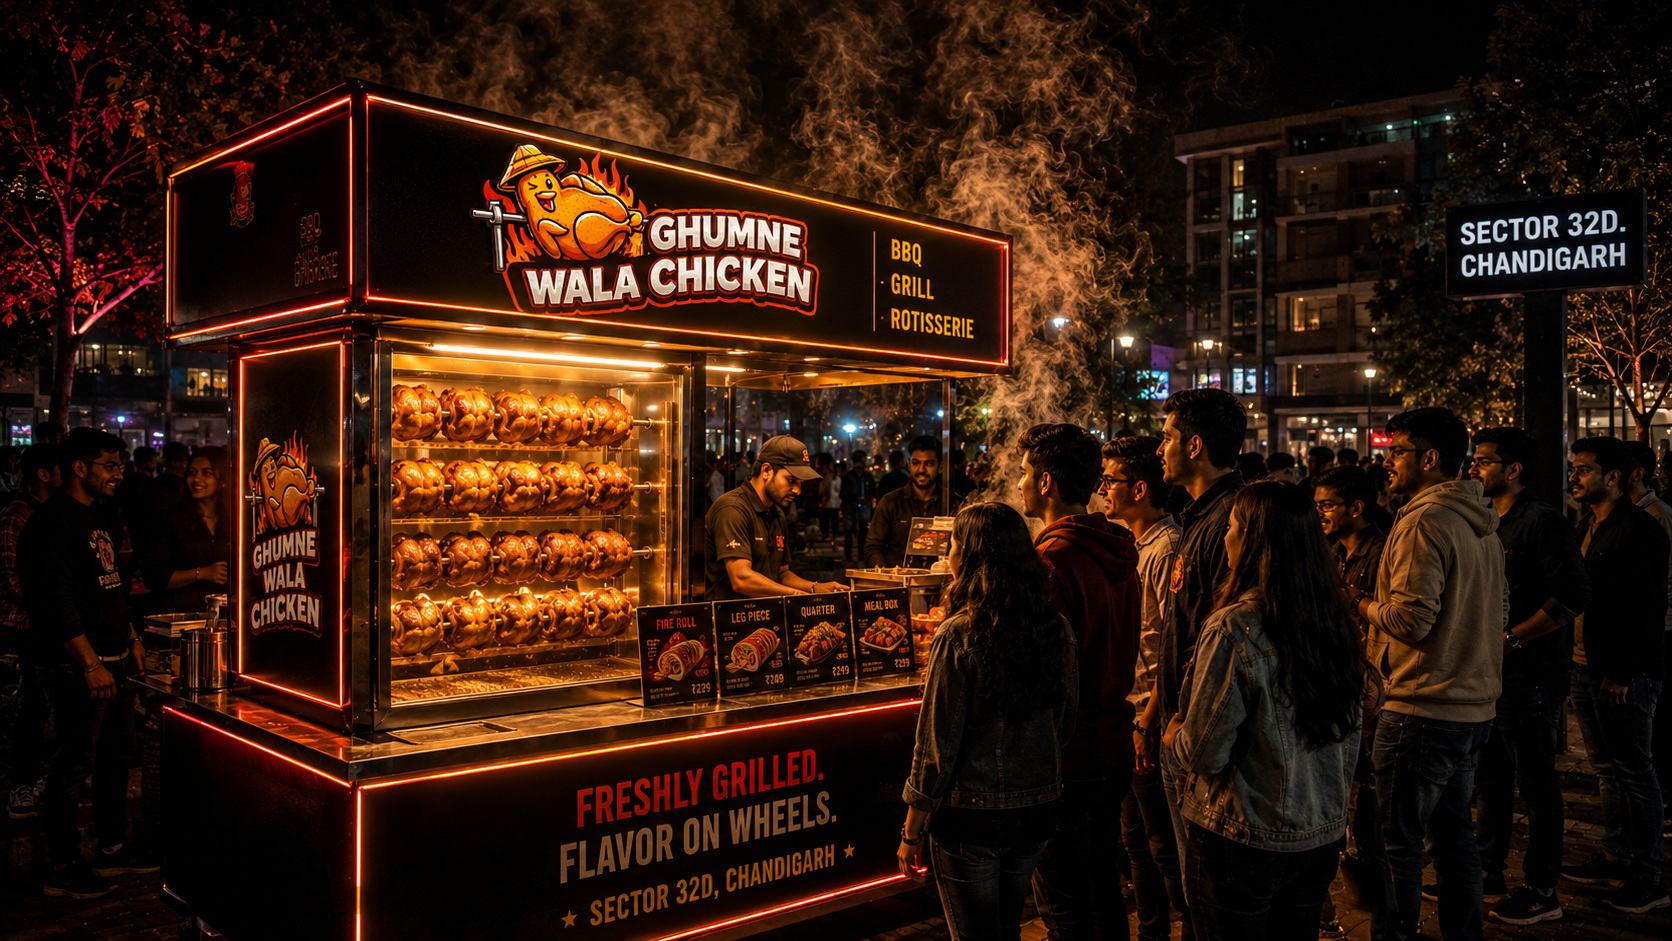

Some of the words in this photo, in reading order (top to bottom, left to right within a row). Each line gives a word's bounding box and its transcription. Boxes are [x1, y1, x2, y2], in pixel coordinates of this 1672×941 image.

[650, 214, 802, 259] GHUMNE
[1460, 215, 1559, 246] SECTOR
[1567, 209, 1626, 237] 32D.
[891, 238, 922, 268] BBQ
[1461, 242, 1626, 278] CHANDIGARH
[524, 265, 641, 306] WALA
[650, 255, 812, 304] CHICKEN
[891, 272, 935, 300] GRILL
[890, 308, 975, 339] ROTISSERIE
[253, 530, 317, 569] GHUMNE
[263, 562, 306, 594] WALA
[251, 593, 320, 629] CHICKEN
[656, 618, 675, 630] FIRE
[676, 616, 697, 629] ROLL
[731, 612, 746, 623] LEG
[748, 610, 771, 621] PIECE
[801, 604, 835, 618] QUARTER
[864, 600, 884, 611] MEAL
[884, 599, 899, 610] BOX
[576, 768, 704, 828] FRESHLY
[712, 749, 825, 800] GRILLED.
[560, 823, 674, 884] FLAVOR
[683, 812, 720, 855] ON
[728, 790, 837, 845] WHEELS.
[589, 884, 669, 927] SECTOR
[676, 873, 719, 904] 32D,
[725, 844, 836, 893] CHANDIGARH
